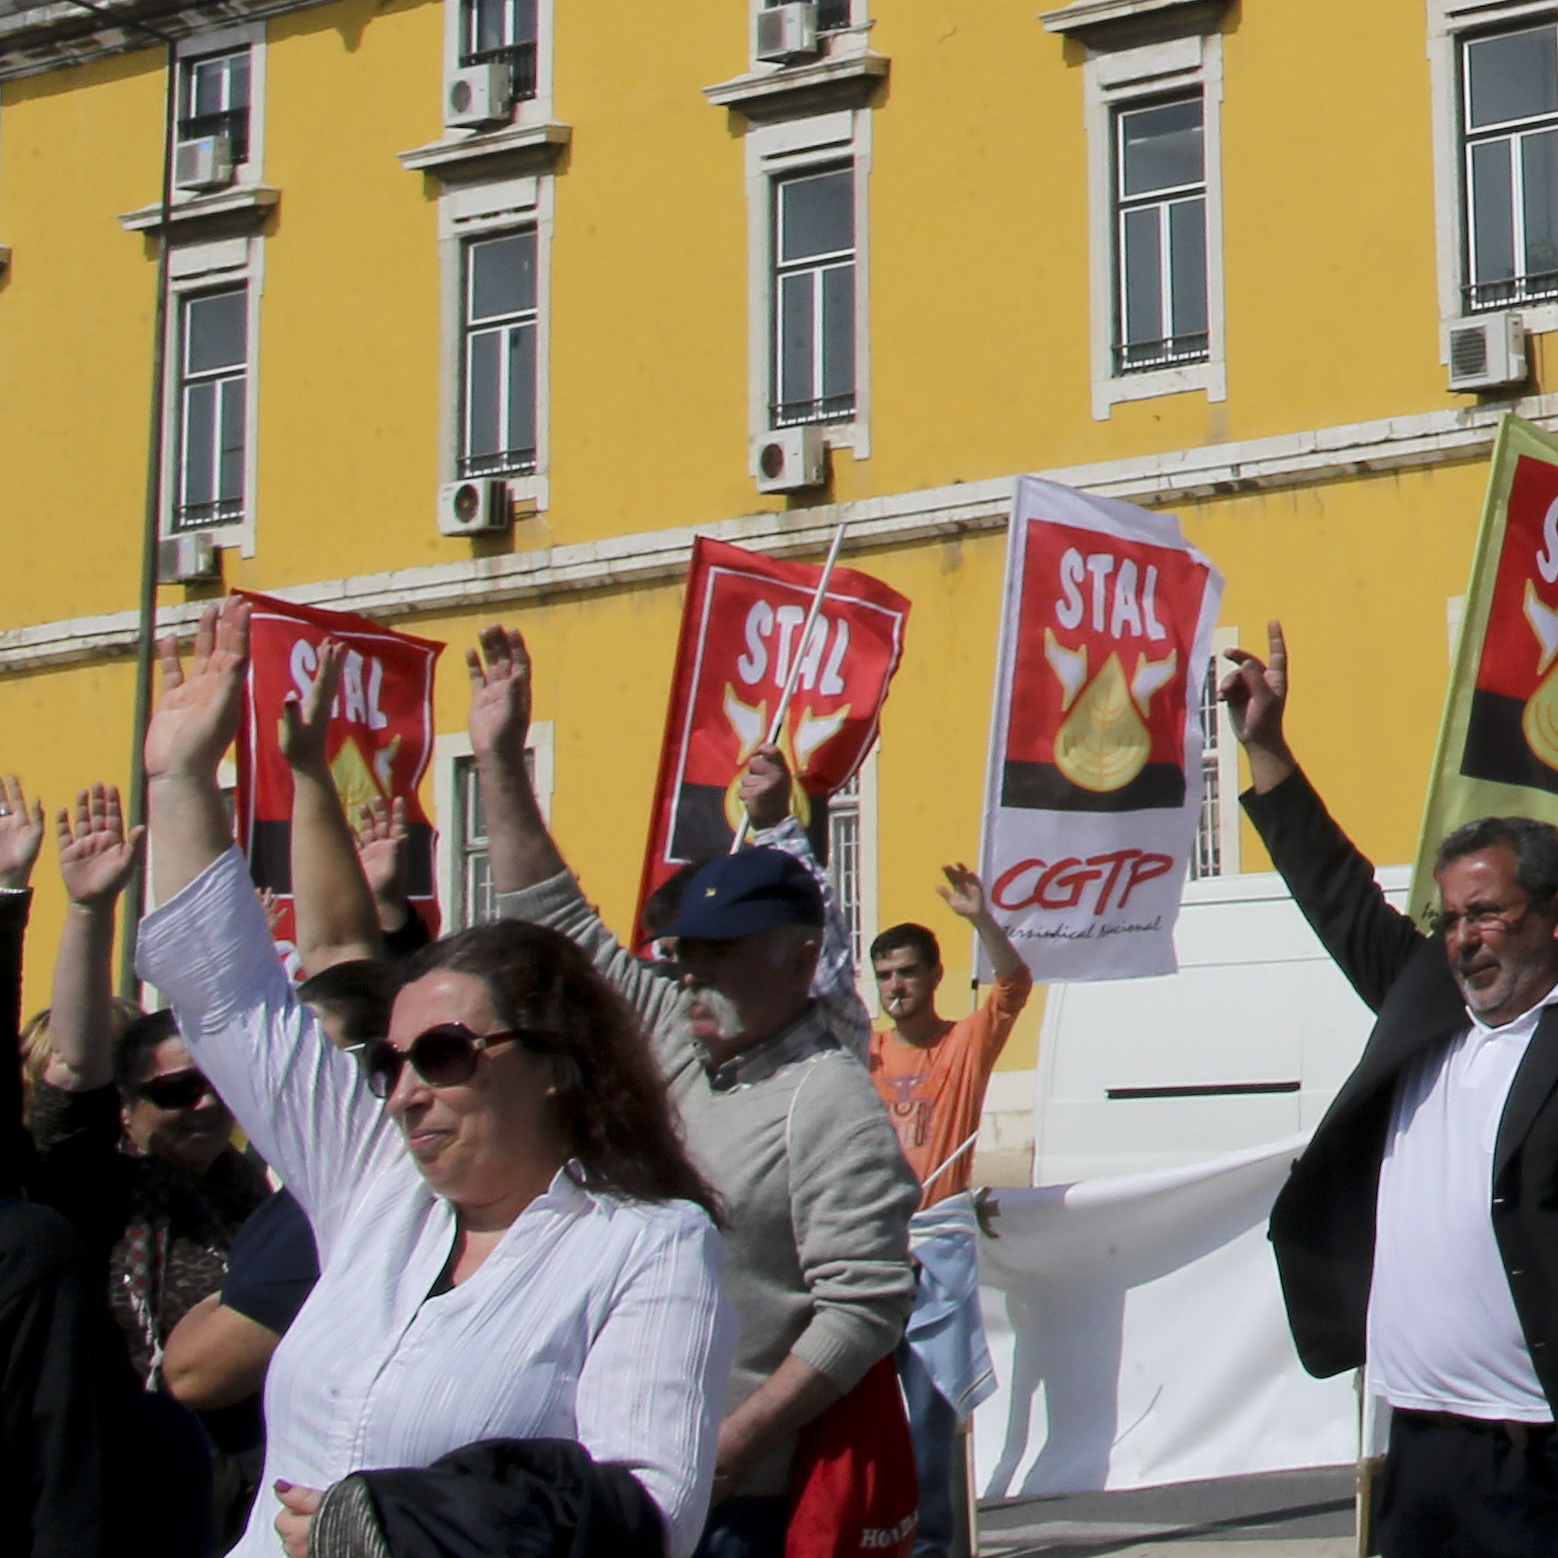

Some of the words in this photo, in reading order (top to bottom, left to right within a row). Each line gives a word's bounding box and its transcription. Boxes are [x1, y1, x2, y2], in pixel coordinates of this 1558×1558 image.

[1055, 547, 1167, 641] STAL
[284, 638, 388, 730] SAL
[737, 599, 850, 696] STAL
[991, 848, 1174, 916] CGTP
